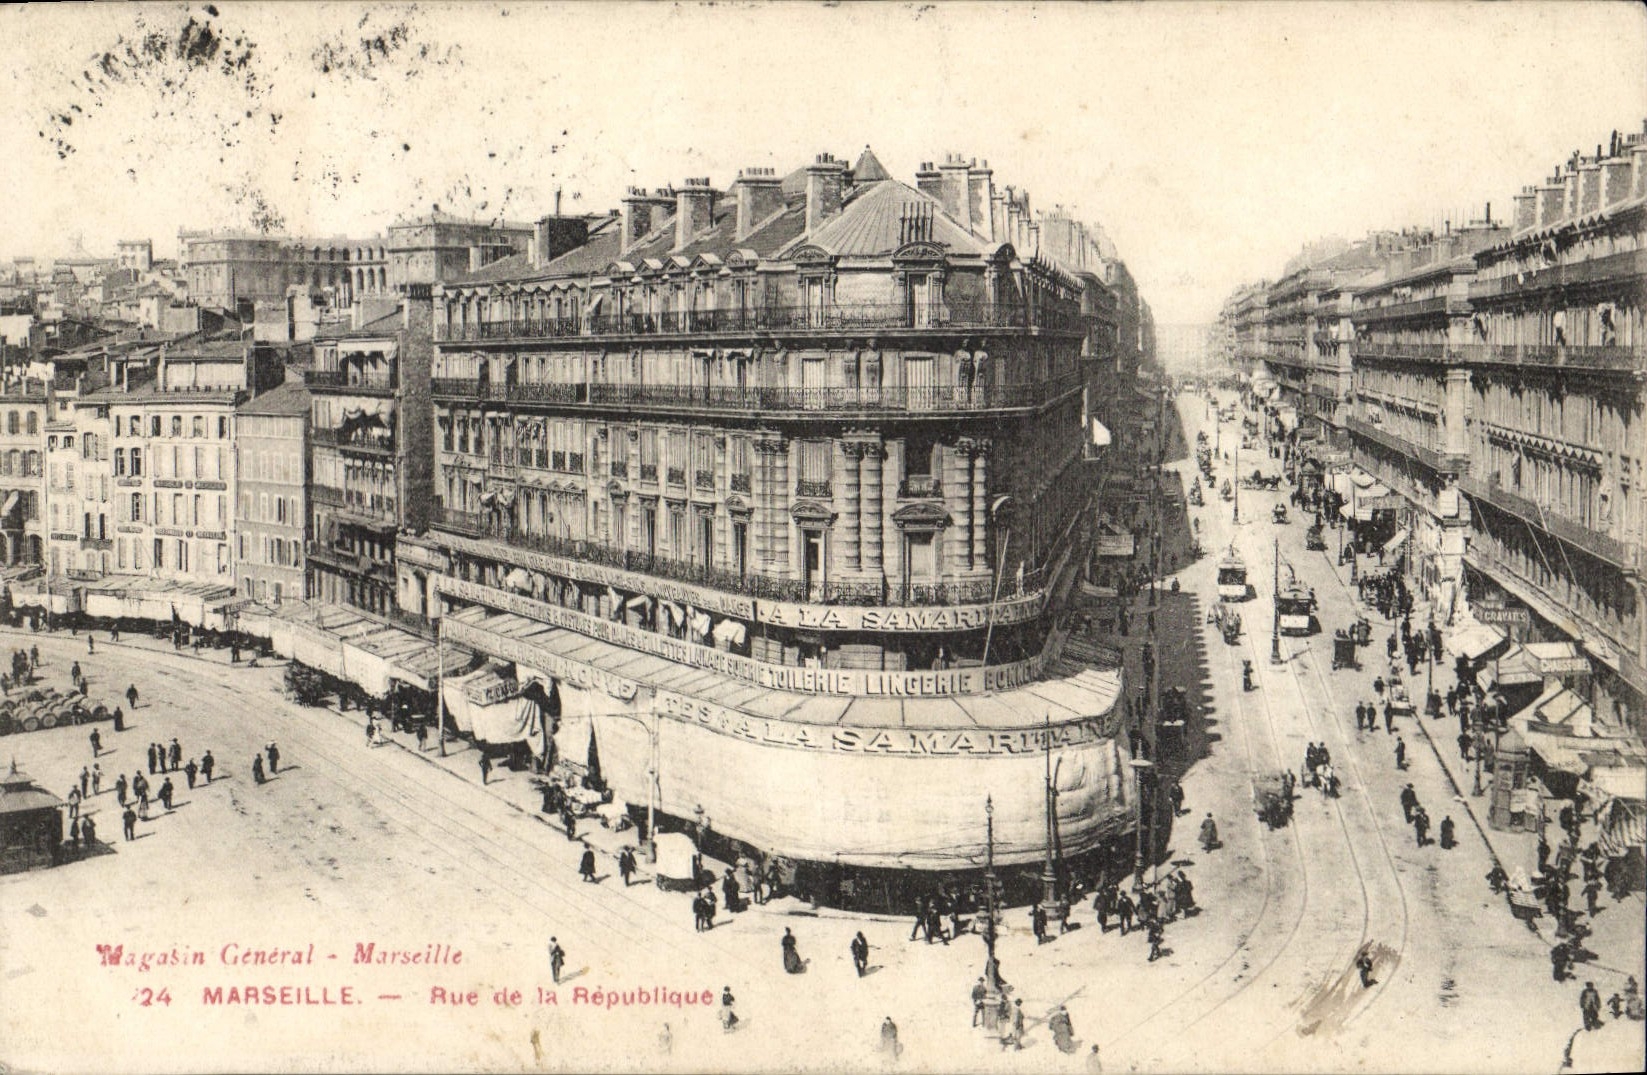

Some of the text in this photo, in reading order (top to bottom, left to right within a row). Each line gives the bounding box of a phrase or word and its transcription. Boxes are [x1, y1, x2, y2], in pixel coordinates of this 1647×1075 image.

[798, 607, 848, 629] LA
[860, 600, 1042, 629] SAMARITAINE
[768, 666, 849, 694] TOILERIE
[865, 673, 972, 695] LINGERIE
[762, 722, 823, 749] LA
[831, 716, 1113, 755] SAMARITAINE
